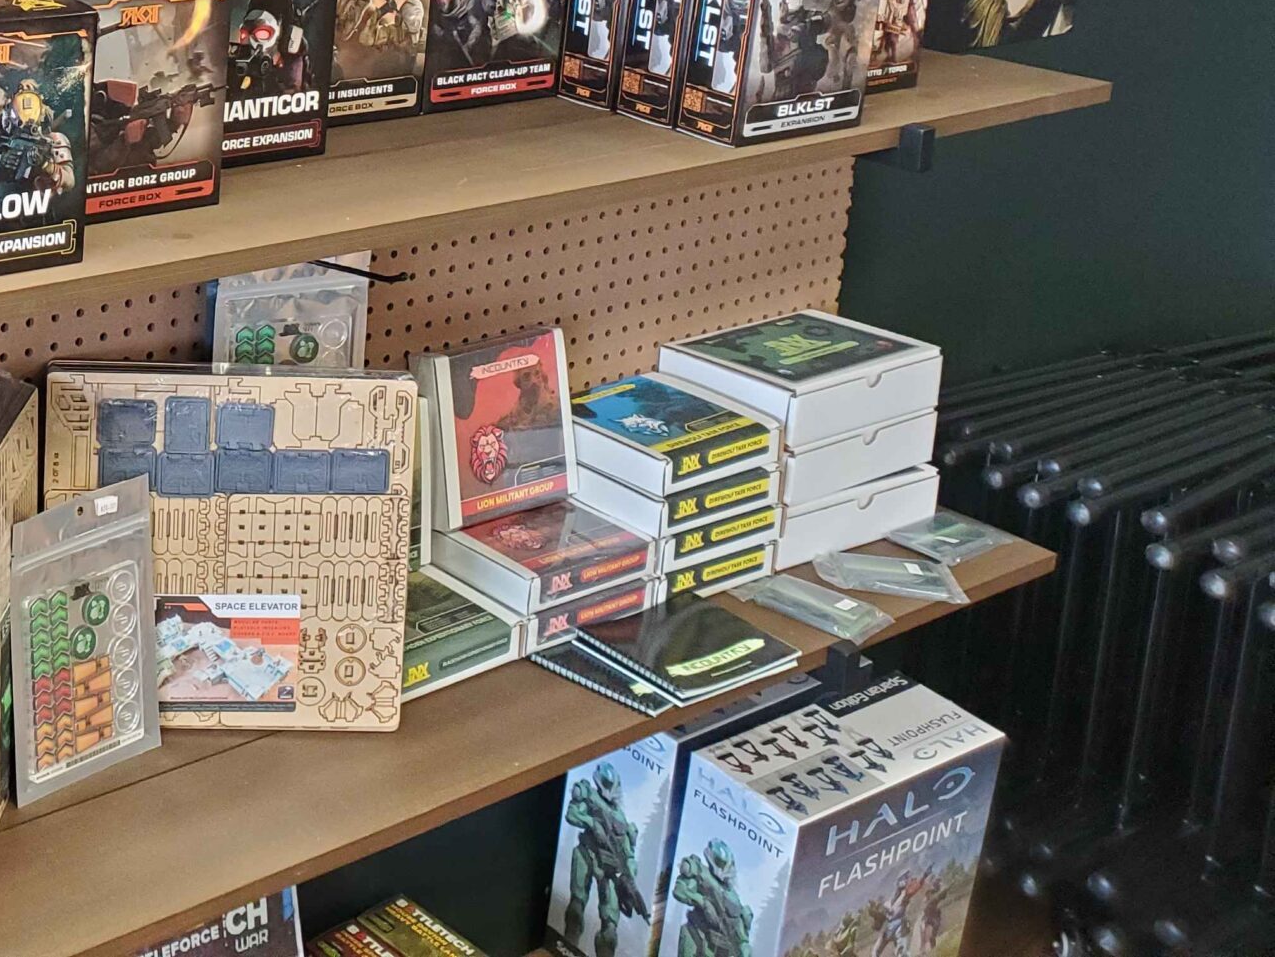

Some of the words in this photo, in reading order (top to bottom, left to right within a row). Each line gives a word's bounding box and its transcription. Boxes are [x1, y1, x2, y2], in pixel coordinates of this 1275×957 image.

[436, 72, 465, 86] BLACK
[466, 70, 488, 84] PACT
[489, 66, 528, 81] CLEAN-UP
[529, 62, 551, 75] TEAM
[337, 84, 394, 99] INSURGENTS
[471, 84, 497, 95] FORCE
[499, 81, 517, 92] BOX
[329, 103, 354, 114] ORCE
[356, 102, 374, 112] BOX
[777, 97, 836, 118] BLKLST
[780, 115, 826, 129] EXPANSION
[252, 127, 313, 150] EXPANSION
[127, 173, 156, 189] BORZ
[159, 168, 197, 185] GROUP
[99, 195, 134, 209] FORCE
[135, 191, 162, 204] BOX
[482, 357, 530, 375] INCOUNTRY
[711, 448, 734, 460] DIREWOLF
[747, 438, 763, 449] FORCE
[477, 498, 495, 510] LION
[496, 490, 528, 505] MILITANT
[529, 481, 554, 496] GROUP
[708, 492, 734, 505] DIREWOLF
[746, 483, 762, 493] FORCE
[715, 525, 739, 537] DIREWOLF
[752, 516, 768, 526] FORCE
[706, 565, 730, 577] DIREWOLF
[742, 556, 758, 566] FORCE
[215, 602, 246, 611] SPACE
[249, 603, 298, 611] ELEVATOR
[865, 676, 909, 699] Spartan
[829, 692, 869, 712] Edition
[886, 711, 962, 747] FLASHPOINT
[912, 724, 987, 760] HALO
[697, 766, 787, 835] HALO
[826, 765, 977, 857] HALO
[694, 789, 785, 859] FLASHPOINT
[817, 811, 969, 899] FLASHPOINT
[396, 899, 475, 955] BATTLETECH
[235, 929, 269, 953] WAR
